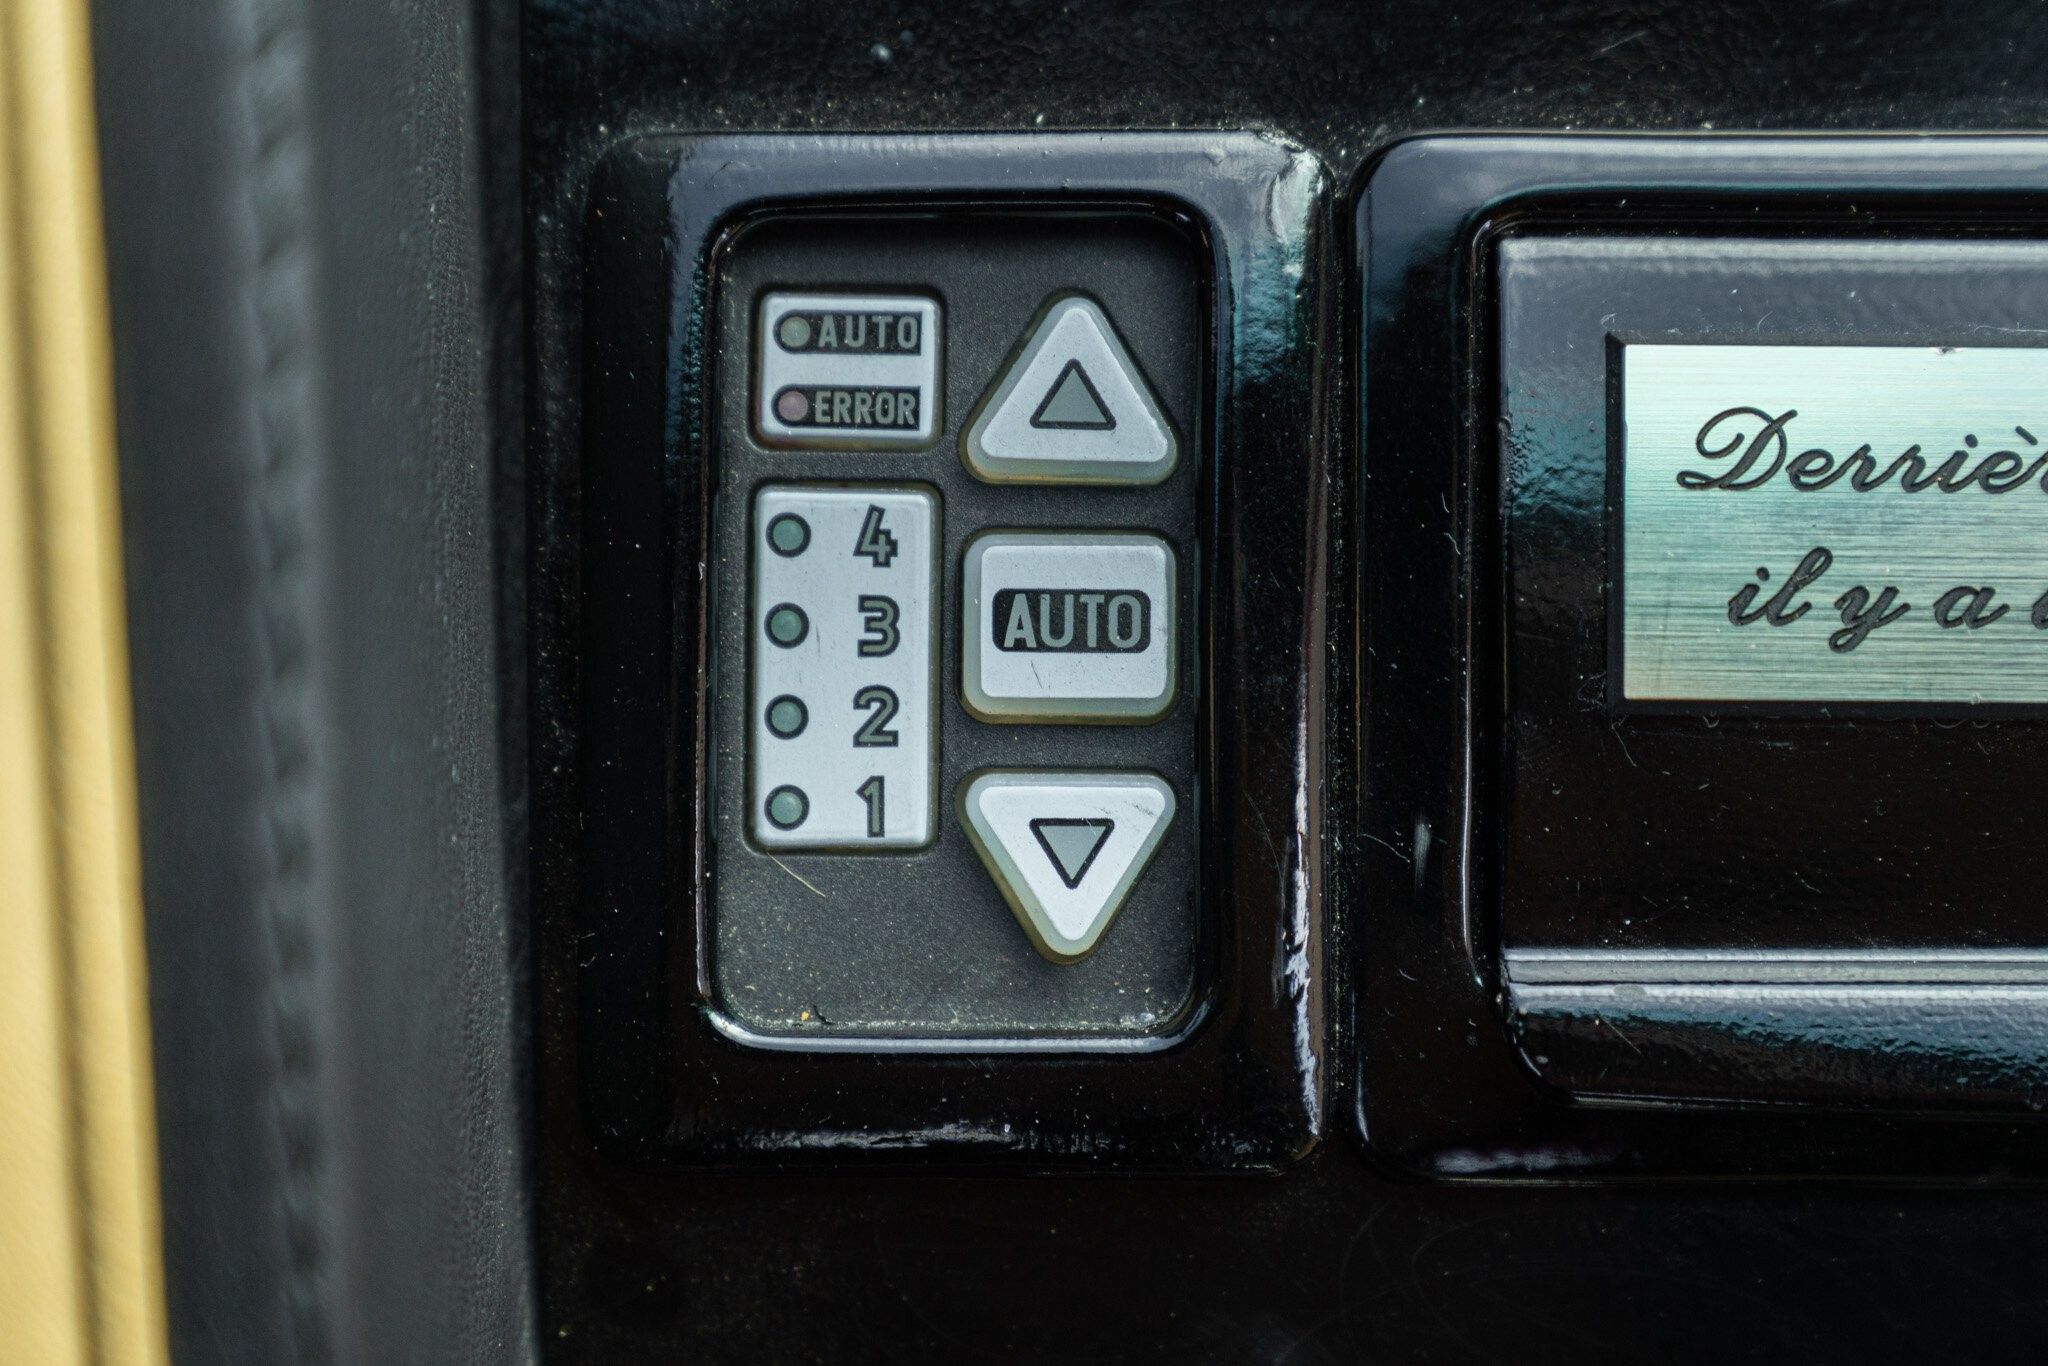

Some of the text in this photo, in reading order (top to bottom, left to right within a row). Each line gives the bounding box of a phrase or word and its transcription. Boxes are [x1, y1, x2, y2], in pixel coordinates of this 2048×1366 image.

[818, 315, 918, 349] AUTO
[815, 391, 916, 425] ERROR
[853, 504, 898, 568] 4
[857, 595, 900, 658] 3
[1003, 594, 1142, 648] AUTO
[1728, 546, 1834, 627] il
[1829, 586, 1911, 653] y
[1933, 586, 2010, 629] a
[853, 685, 899, 748] 2
[855, 775, 885, 838] 1
